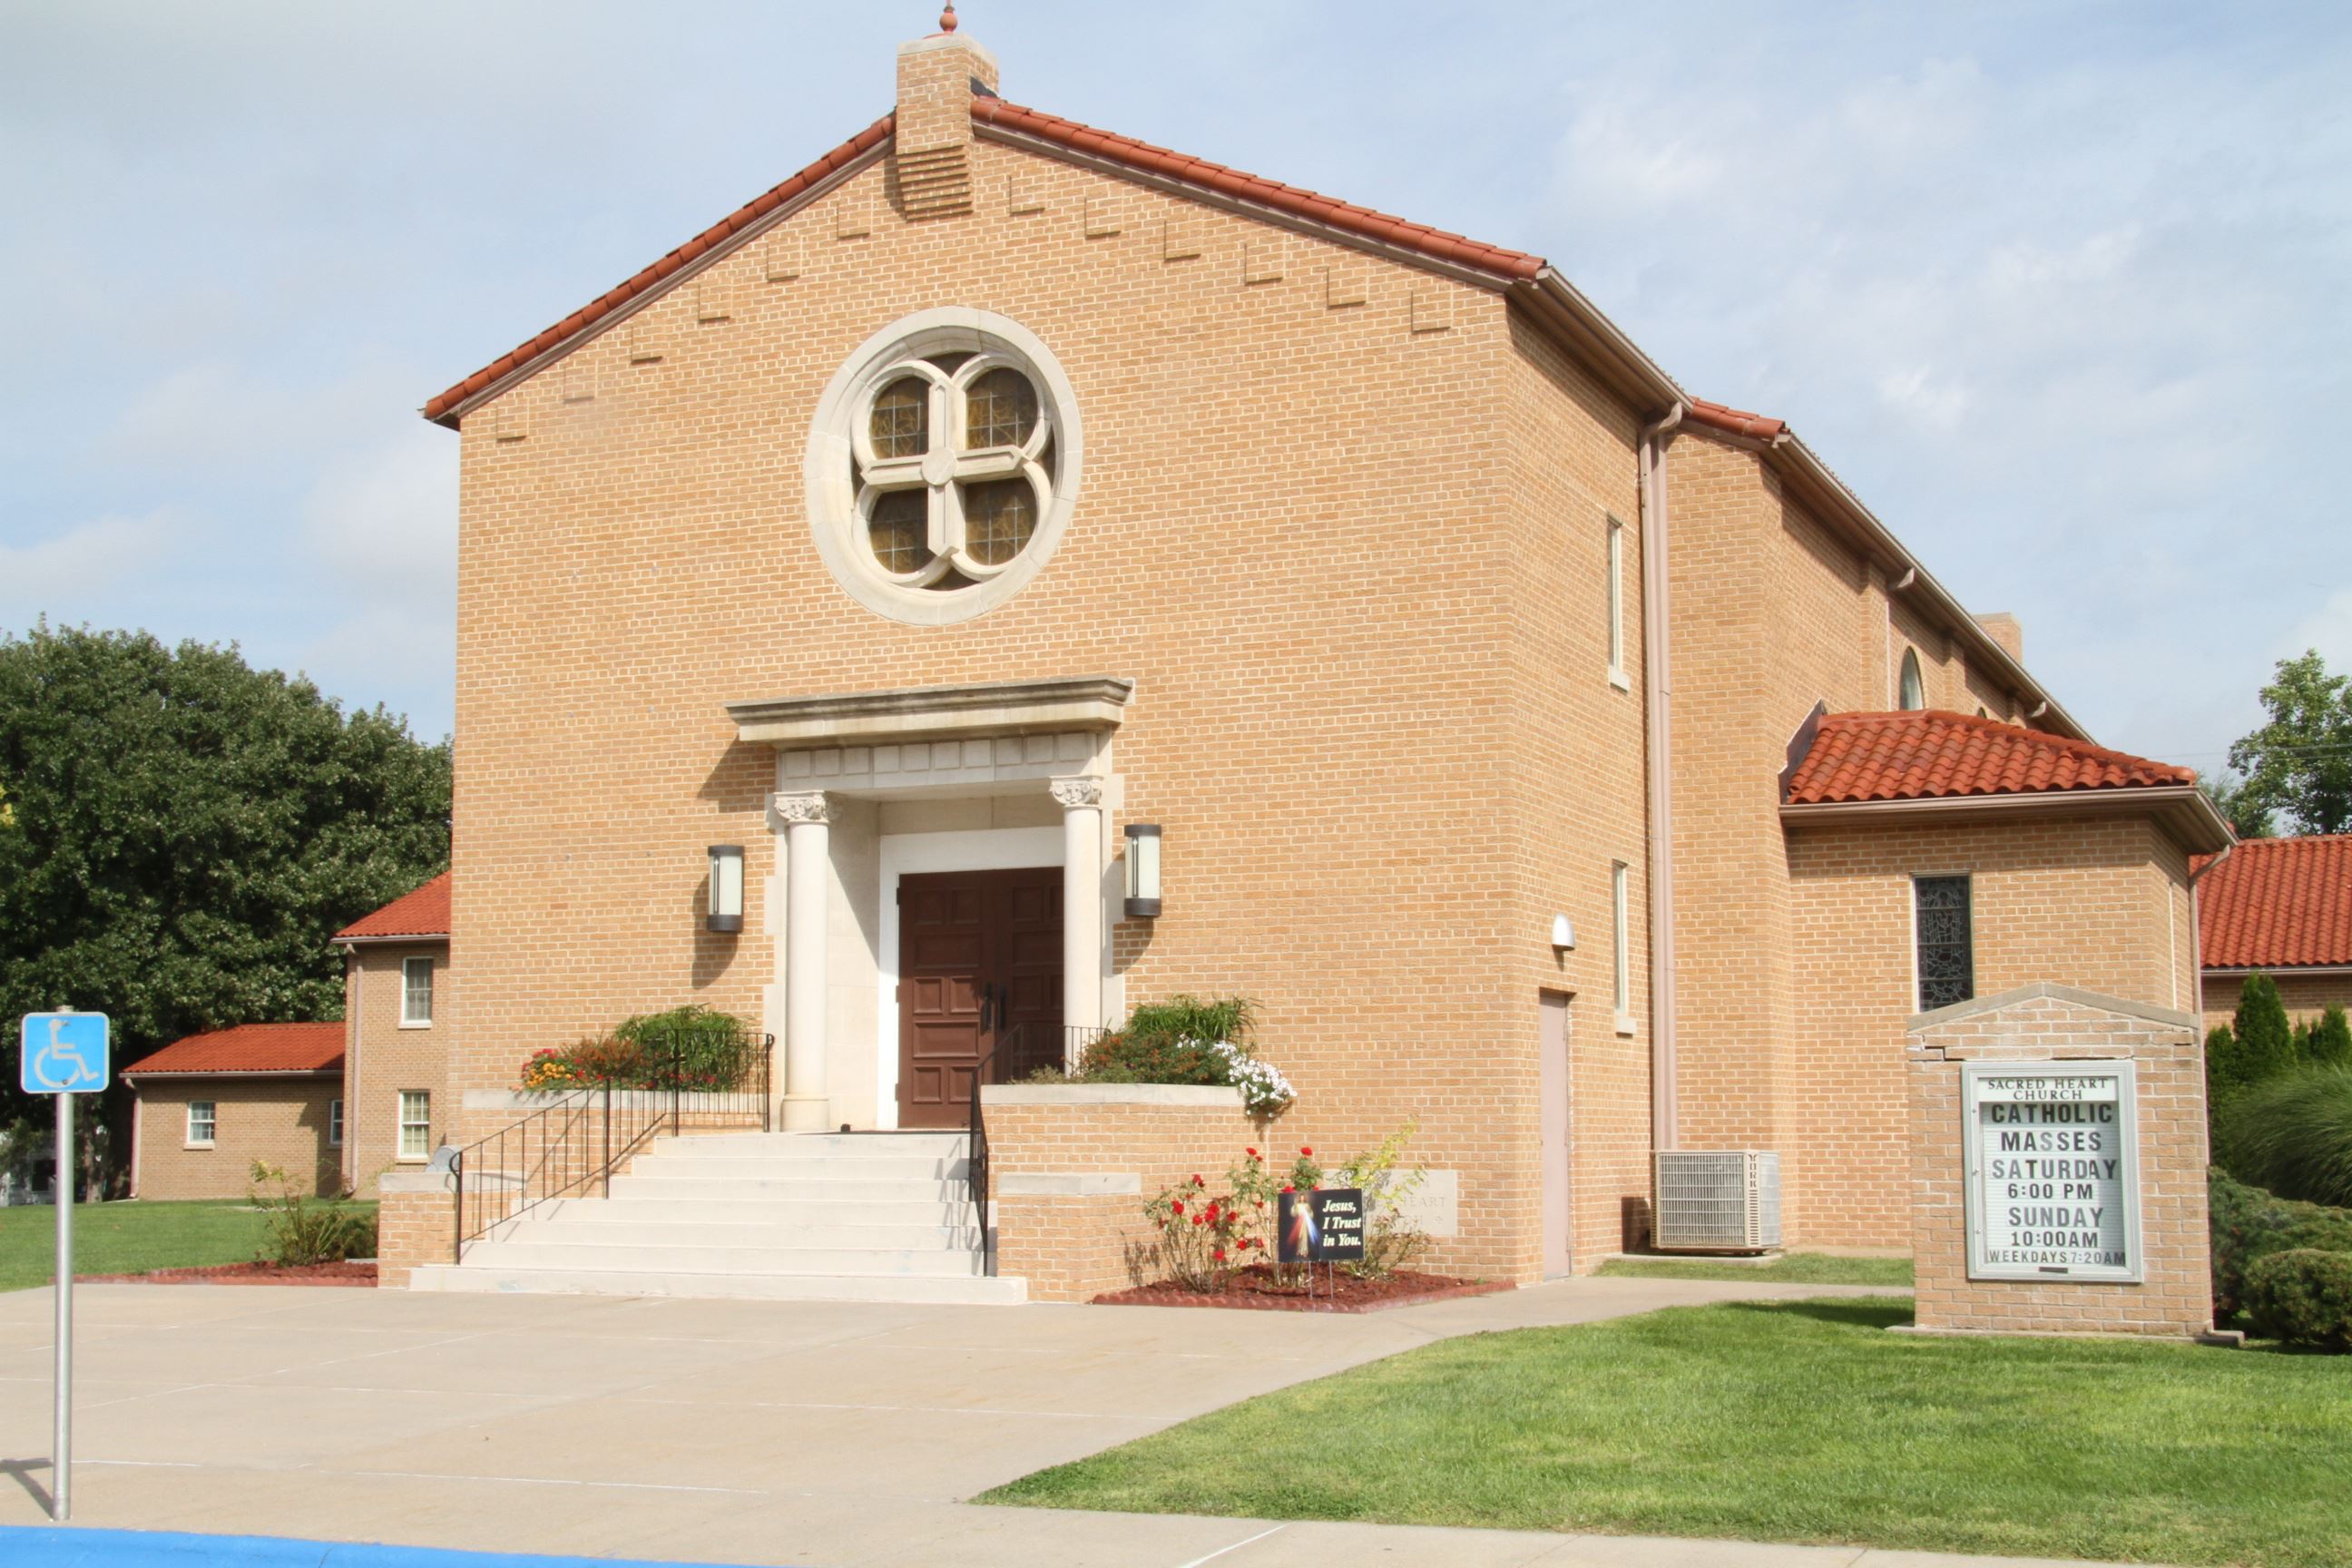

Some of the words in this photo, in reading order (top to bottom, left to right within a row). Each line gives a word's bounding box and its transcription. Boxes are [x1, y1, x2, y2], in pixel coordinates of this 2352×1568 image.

[1988, 1079, 2045, 1089] SACRED
[2054, 1078, 2109, 1089] HEART
[2014, 1090, 2082, 1100] CHURCH
[1991, 1103, 2112, 1122] CATHOLIC
[2001, 1132, 2102, 1152] MASSES
[1748, 1153, 1758, 1188] YORK
[1992, 1160, 2117, 1180] SATURDAY
[2008, 1183, 2053, 1199] 6:00
[2063, 1183, 2092, 1200] PM
[1322, 1200, 1357, 1213] Jesus,
[1322, 1217, 1330, 1230] I
[1332, 1216, 1362, 1230] Trust
[2008, 1207, 2103, 1227] SUNDAY
[1323, 1234, 1335, 1247] in
[1338, 1233, 1361, 1247] You.
[1989, 1250, 2067, 1263] WEEKDAYS
